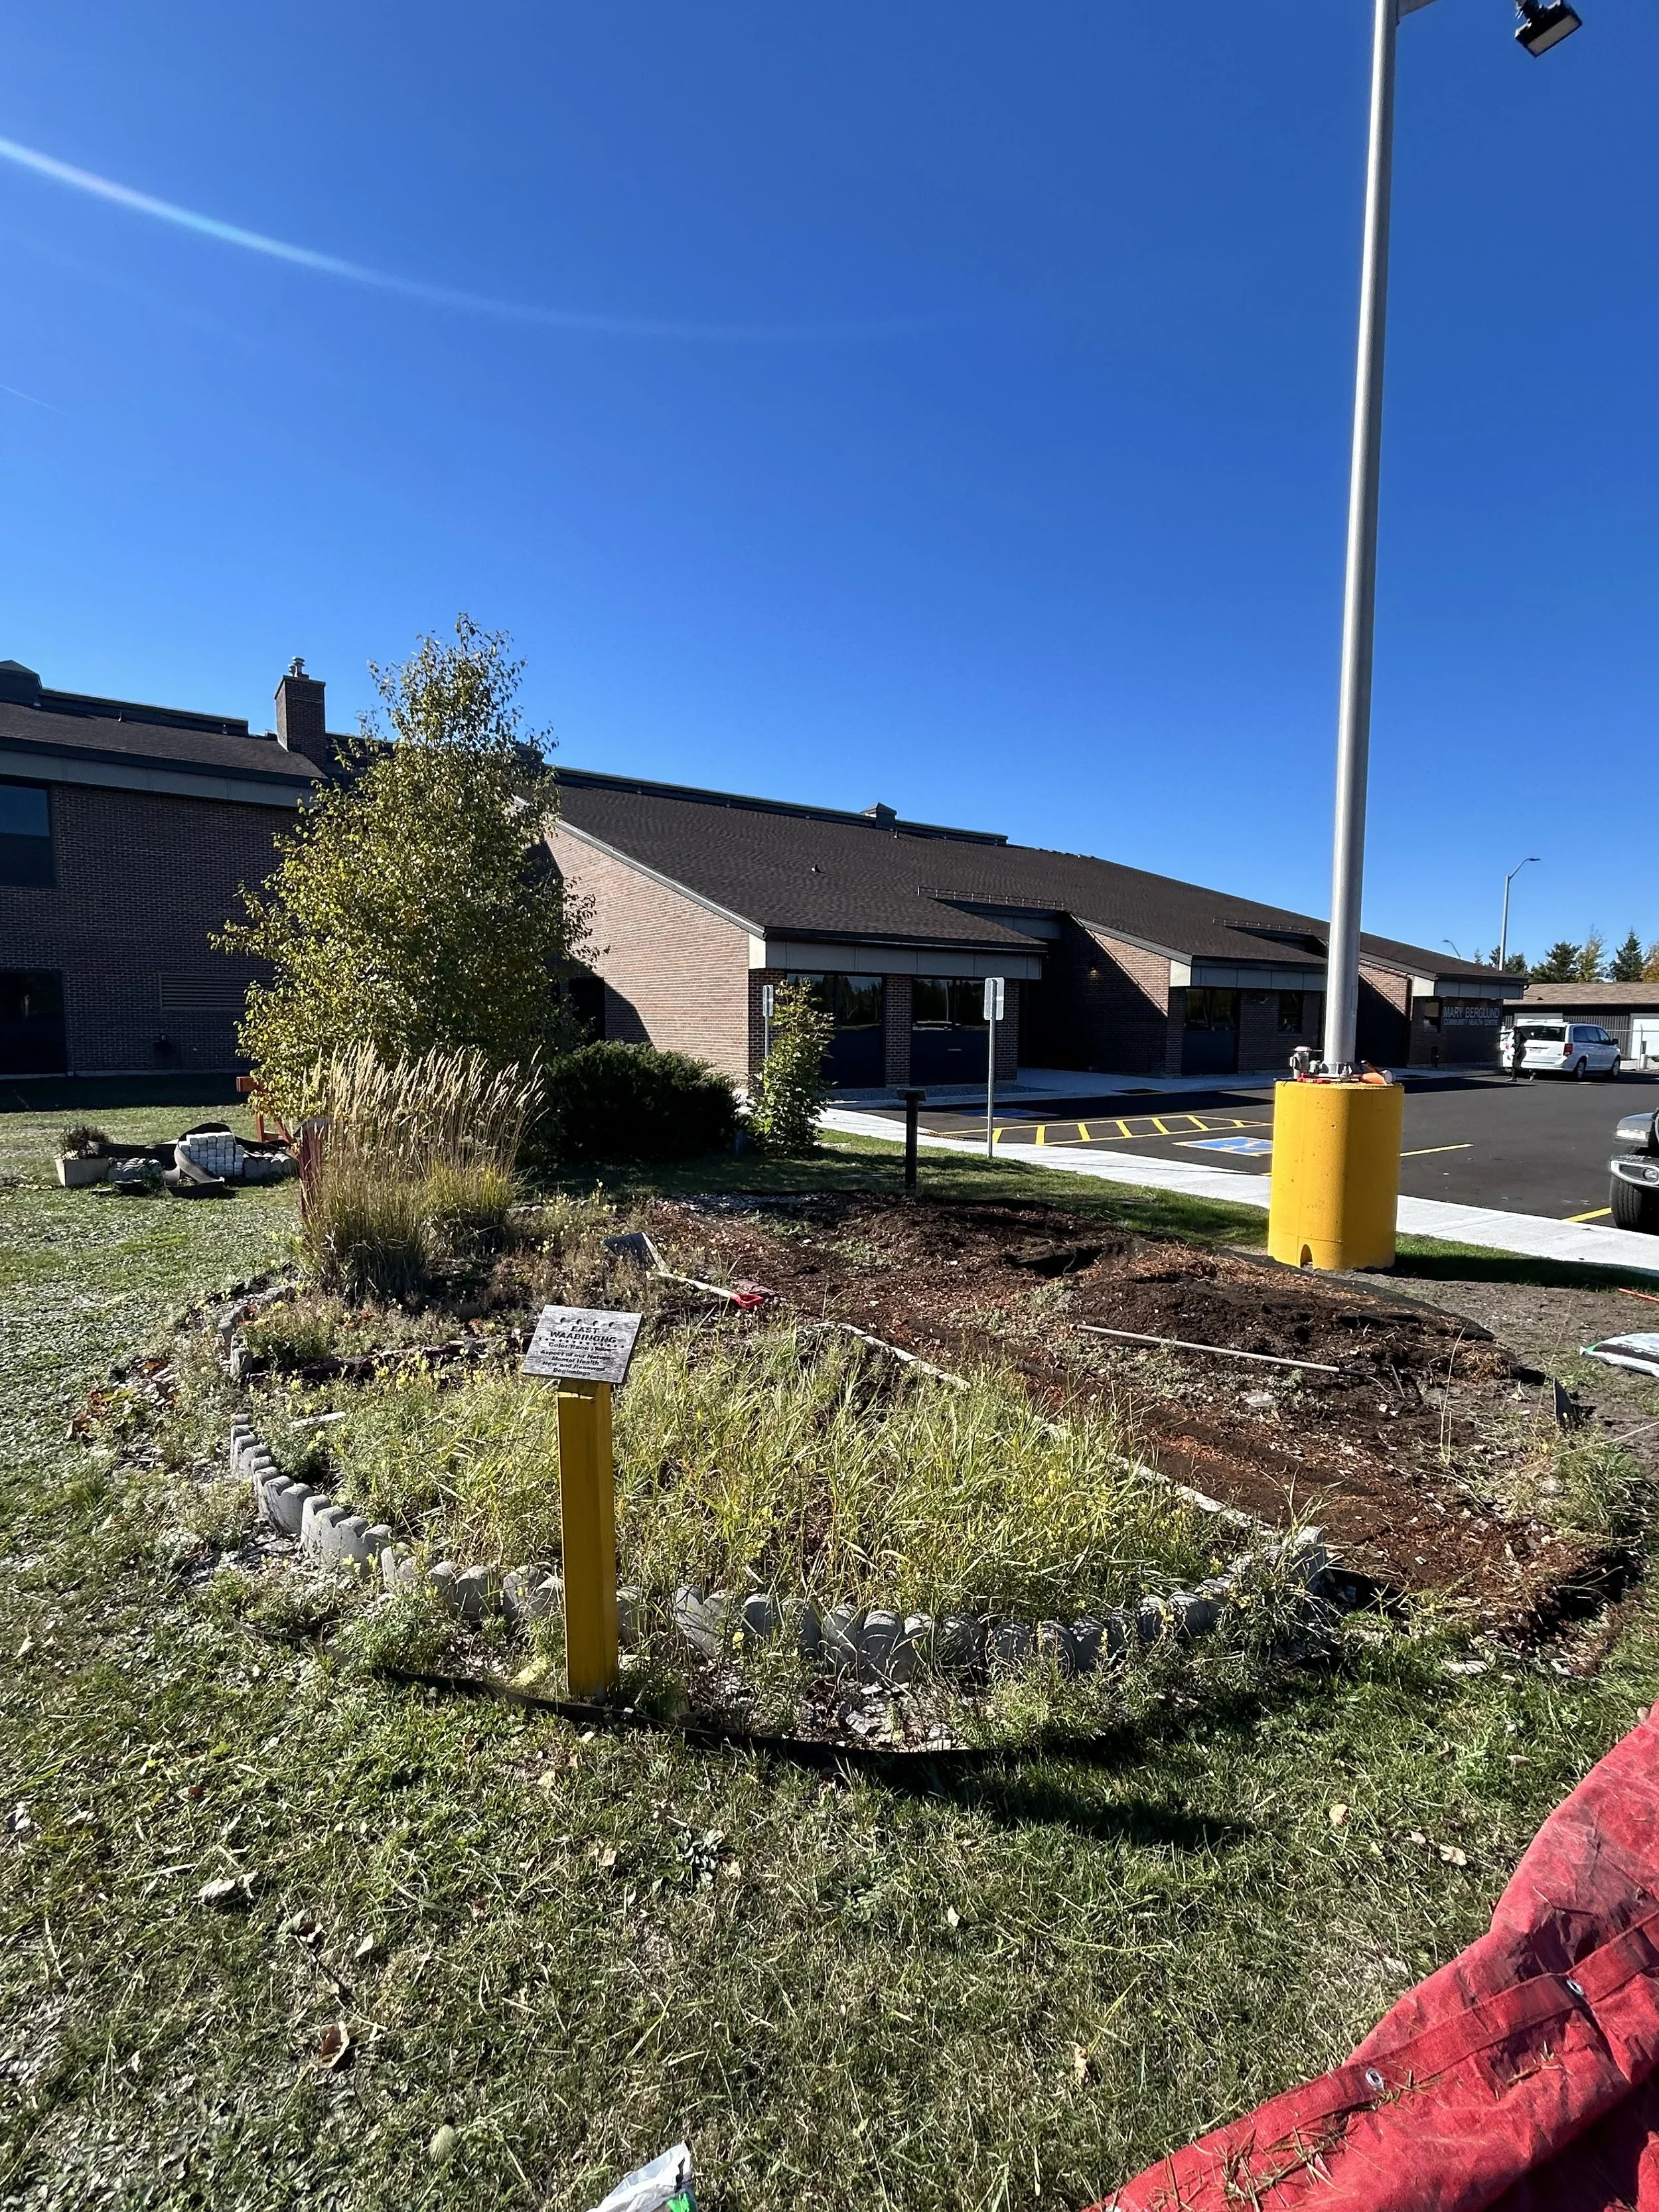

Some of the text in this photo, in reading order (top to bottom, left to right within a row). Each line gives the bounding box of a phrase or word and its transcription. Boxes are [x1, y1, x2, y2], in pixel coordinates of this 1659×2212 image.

[1443, 1006, 1500, 1018] MARY BERGLUND
[550, 1331, 617, 1343] WAABINONG
[553, 1368, 591, 1376] Beginnings
